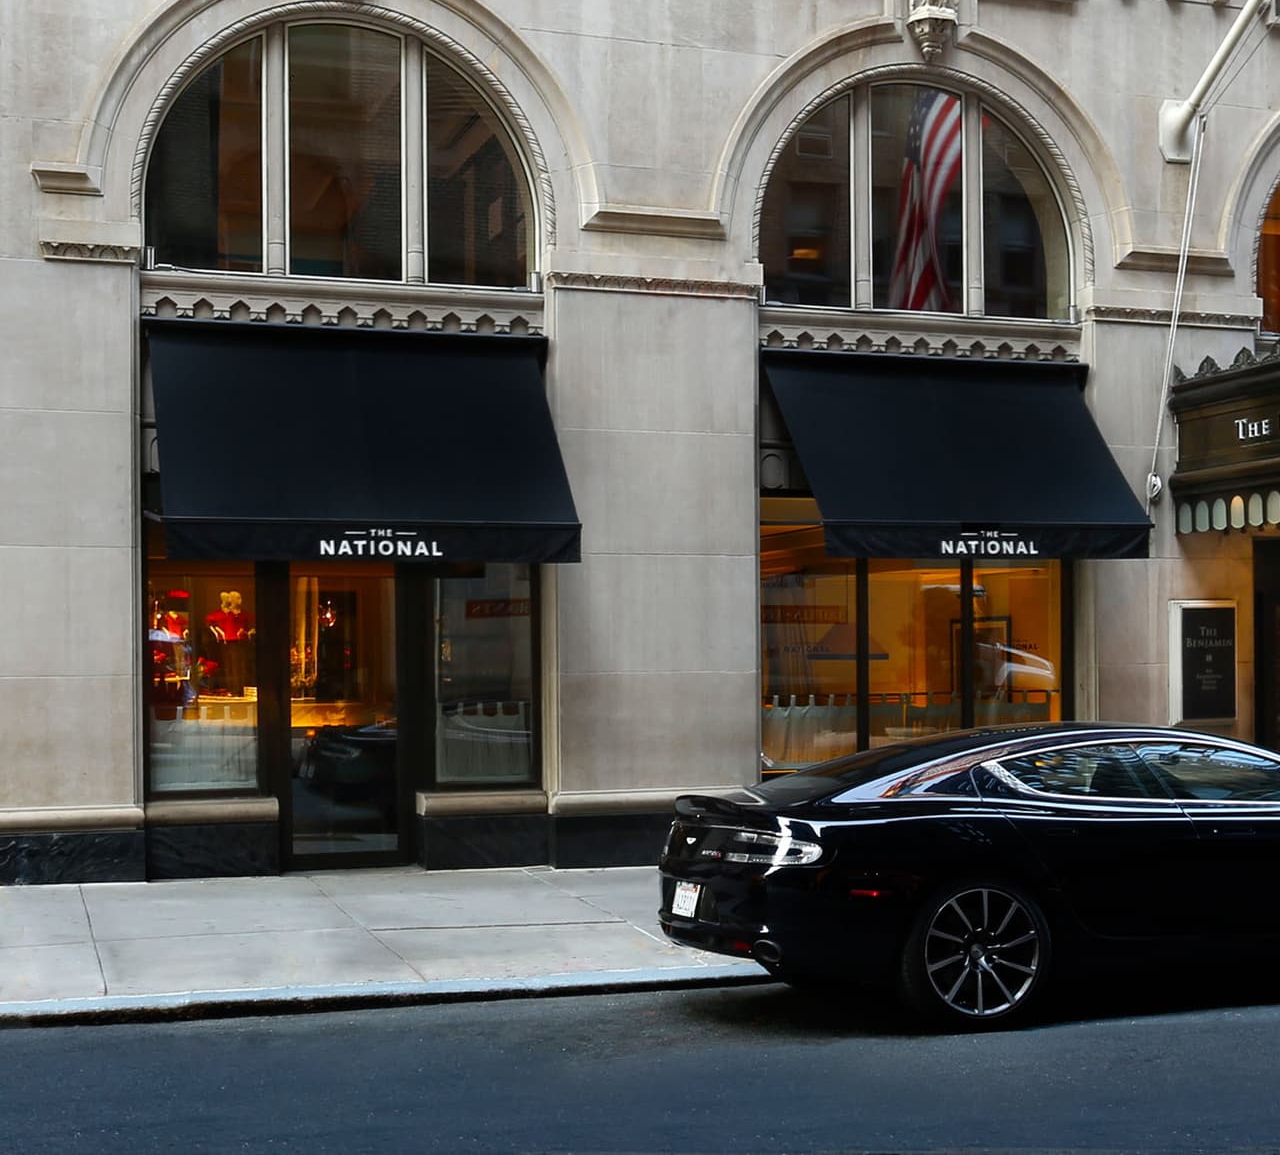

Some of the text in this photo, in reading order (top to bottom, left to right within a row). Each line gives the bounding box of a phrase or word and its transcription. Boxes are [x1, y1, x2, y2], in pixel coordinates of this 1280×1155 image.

[1234, 418, 1270, 440] THE
[369, 529, 393, 537] THE
[980, 530, 999, 538] THE
[320, 540, 443, 556] NATIONAL
[941, 540, 1039, 555] NATIONAL
[1184, 637, 1233, 649] BENJAMIN
